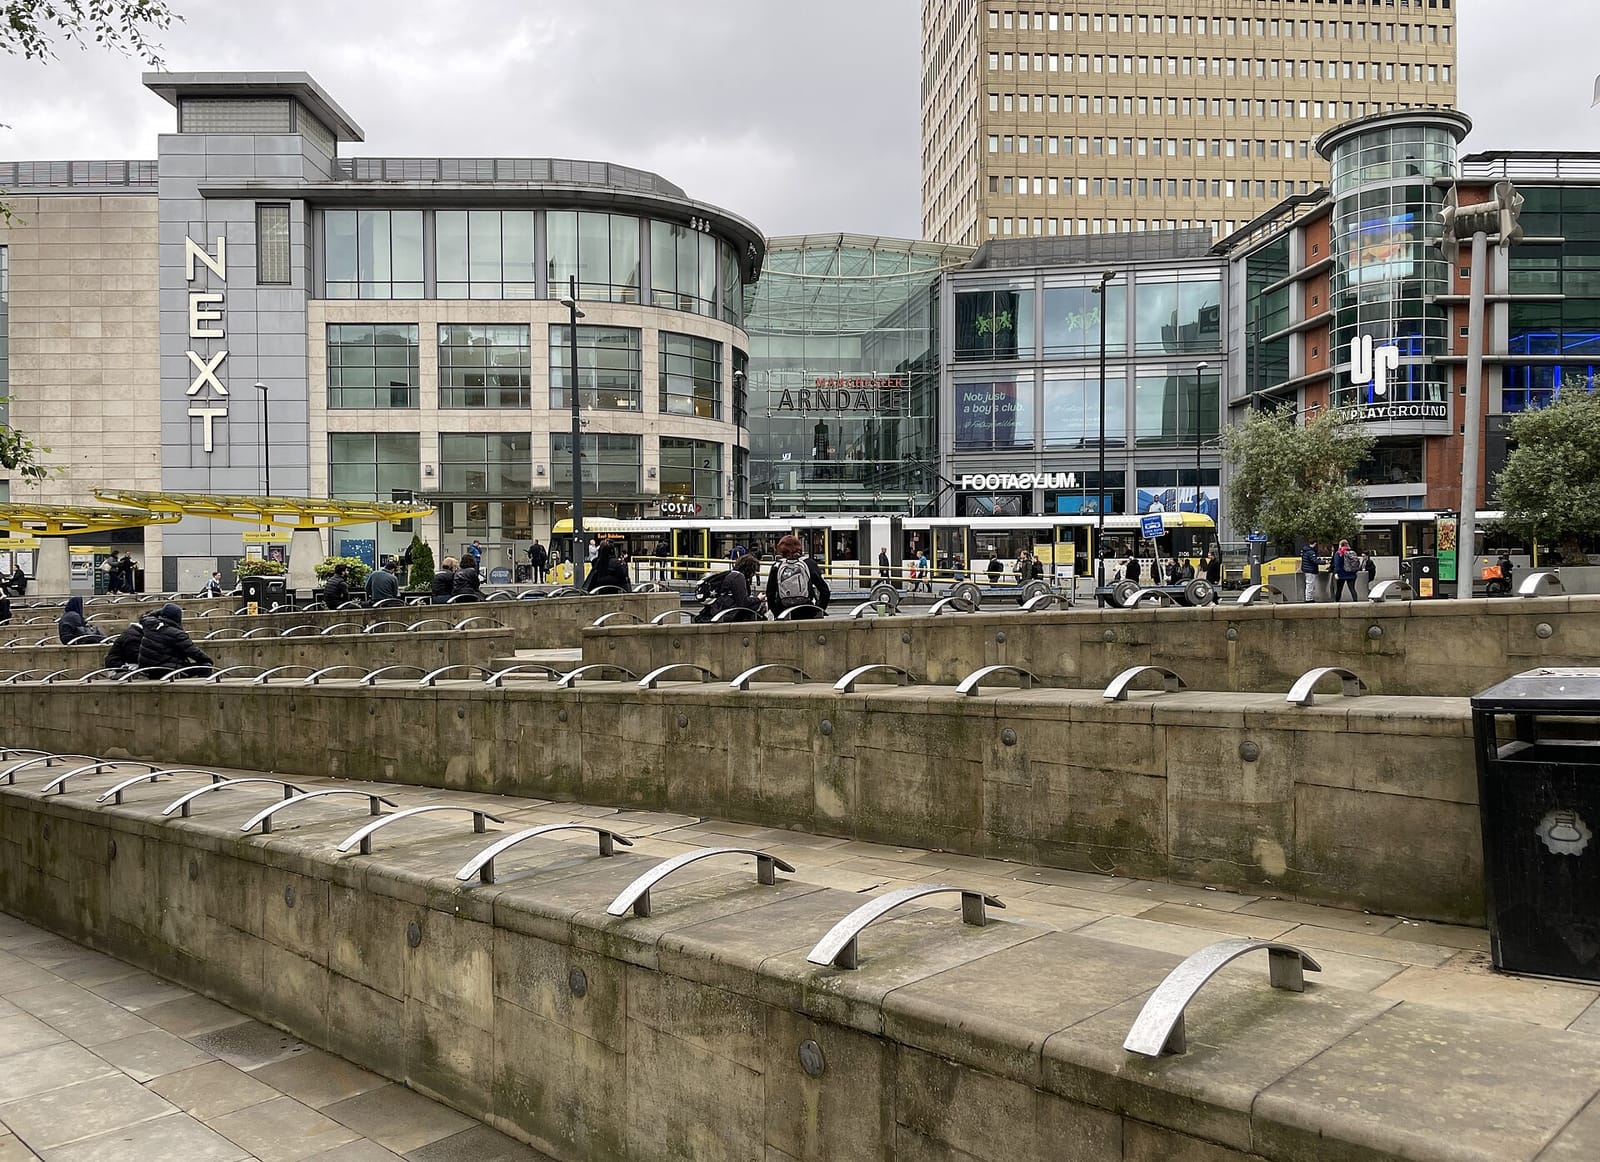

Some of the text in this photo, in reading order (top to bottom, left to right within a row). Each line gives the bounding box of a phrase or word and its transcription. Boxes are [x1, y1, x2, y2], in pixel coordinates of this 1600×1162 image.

[184, 235, 230, 453] NEXT
[816, 377, 902, 389] MANCHESTER
[777, 388, 903, 411] ARNDALE
[963, 391, 1006, 403] Not just
[1001, 402, 1025, 412] club.
[703, 459, 710, 468] 2
[661, 502, 695, 513] COSTA
